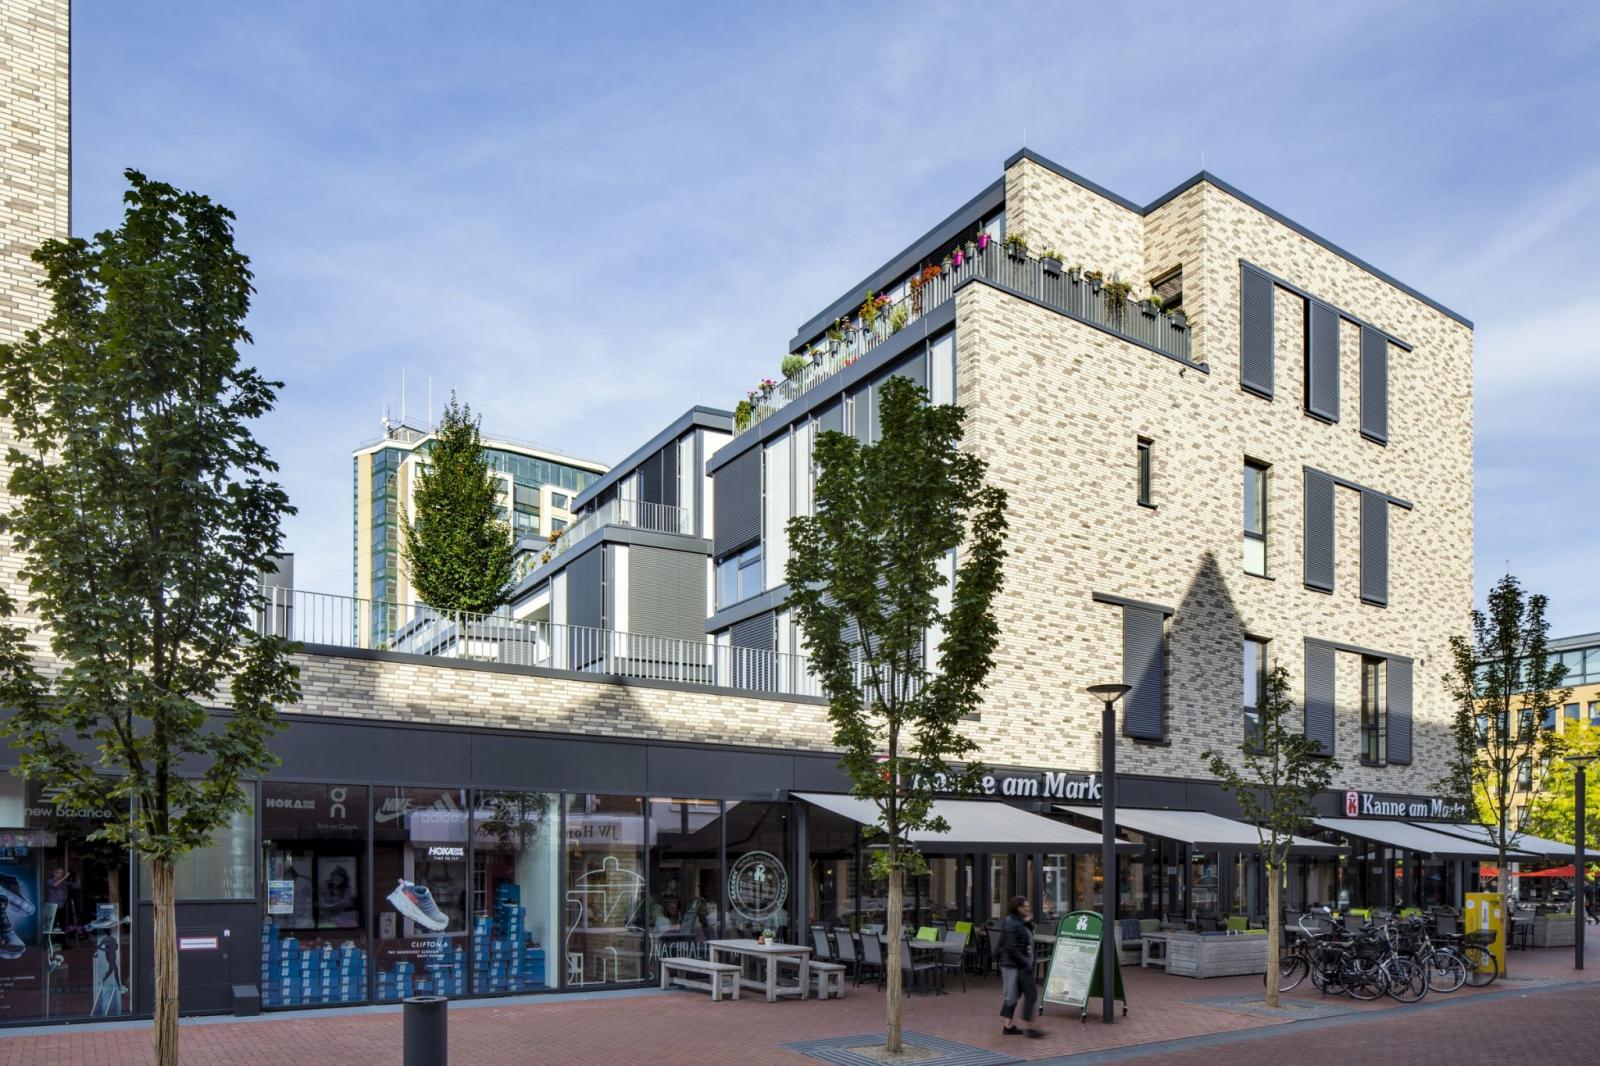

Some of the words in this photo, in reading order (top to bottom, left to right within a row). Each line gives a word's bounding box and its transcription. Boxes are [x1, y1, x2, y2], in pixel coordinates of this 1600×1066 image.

[912, 773, 995, 795] Kae
[1003, 778, 1037, 797] am
[1044, 771, 1102, 799] Mark
[24, 806, 52, 817] new
[56, 803, 112, 818] baance
[265, 798, 302, 808] HOKA
[382, 797, 415, 811] NIKE
[1362, 794, 1406, 816] Kanne
[1409, 803, 1428, 817] am
[655, 941, 710, 960] NACHHALT
